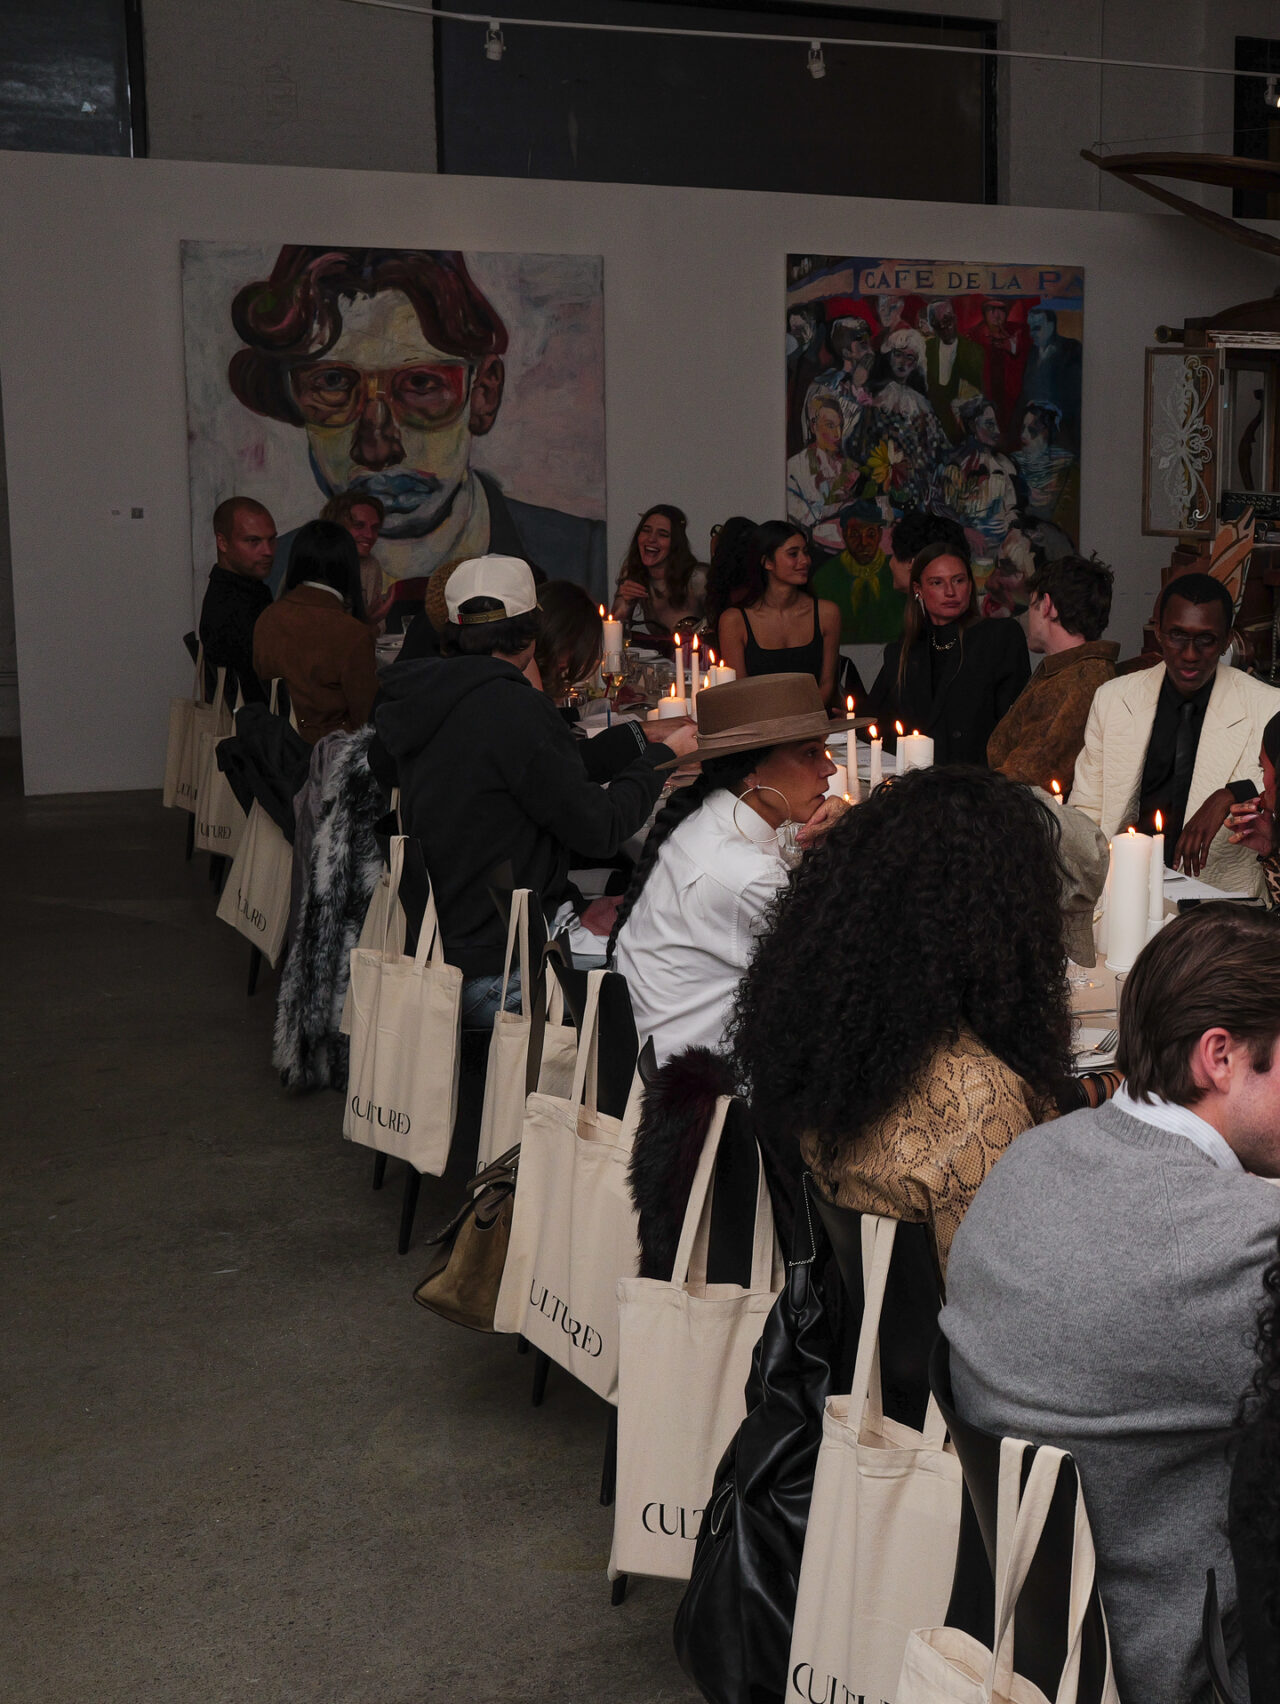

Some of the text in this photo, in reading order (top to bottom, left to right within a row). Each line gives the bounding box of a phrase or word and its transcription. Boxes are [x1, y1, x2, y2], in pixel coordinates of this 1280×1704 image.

[864, 269, 934, 290] CAFE
[947, 271, 981, 290] DE
[991, 272, 1022, 290] LA
[529, 1278, 603, 1358] ULTURED
